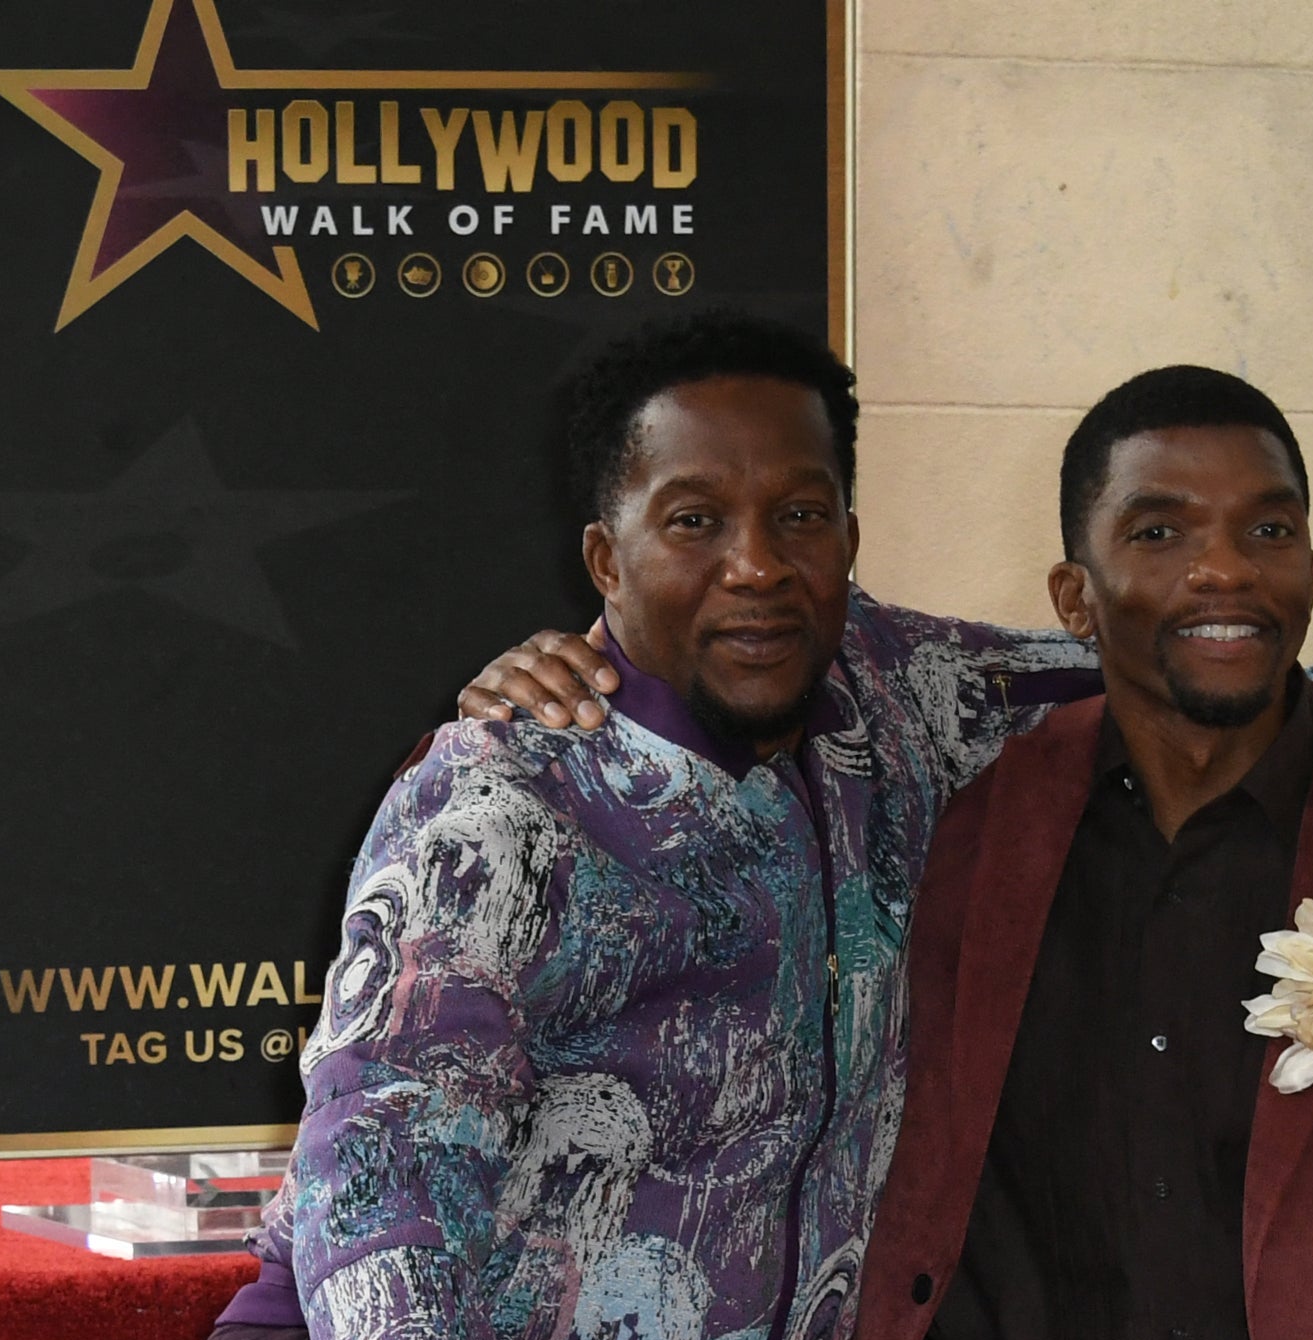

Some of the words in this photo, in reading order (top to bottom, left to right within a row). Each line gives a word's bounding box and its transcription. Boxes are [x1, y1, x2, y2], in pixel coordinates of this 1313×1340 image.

[227, 99, 698, 193] HOLLYWOOD
[261, 205, 415, 236] WALK
[448, 205, 516, 236] OF
[551, 204, 695, 236] FAME
[80, 1031, 168, 1065] TAG
[185, 1029, 245, 1062] US
